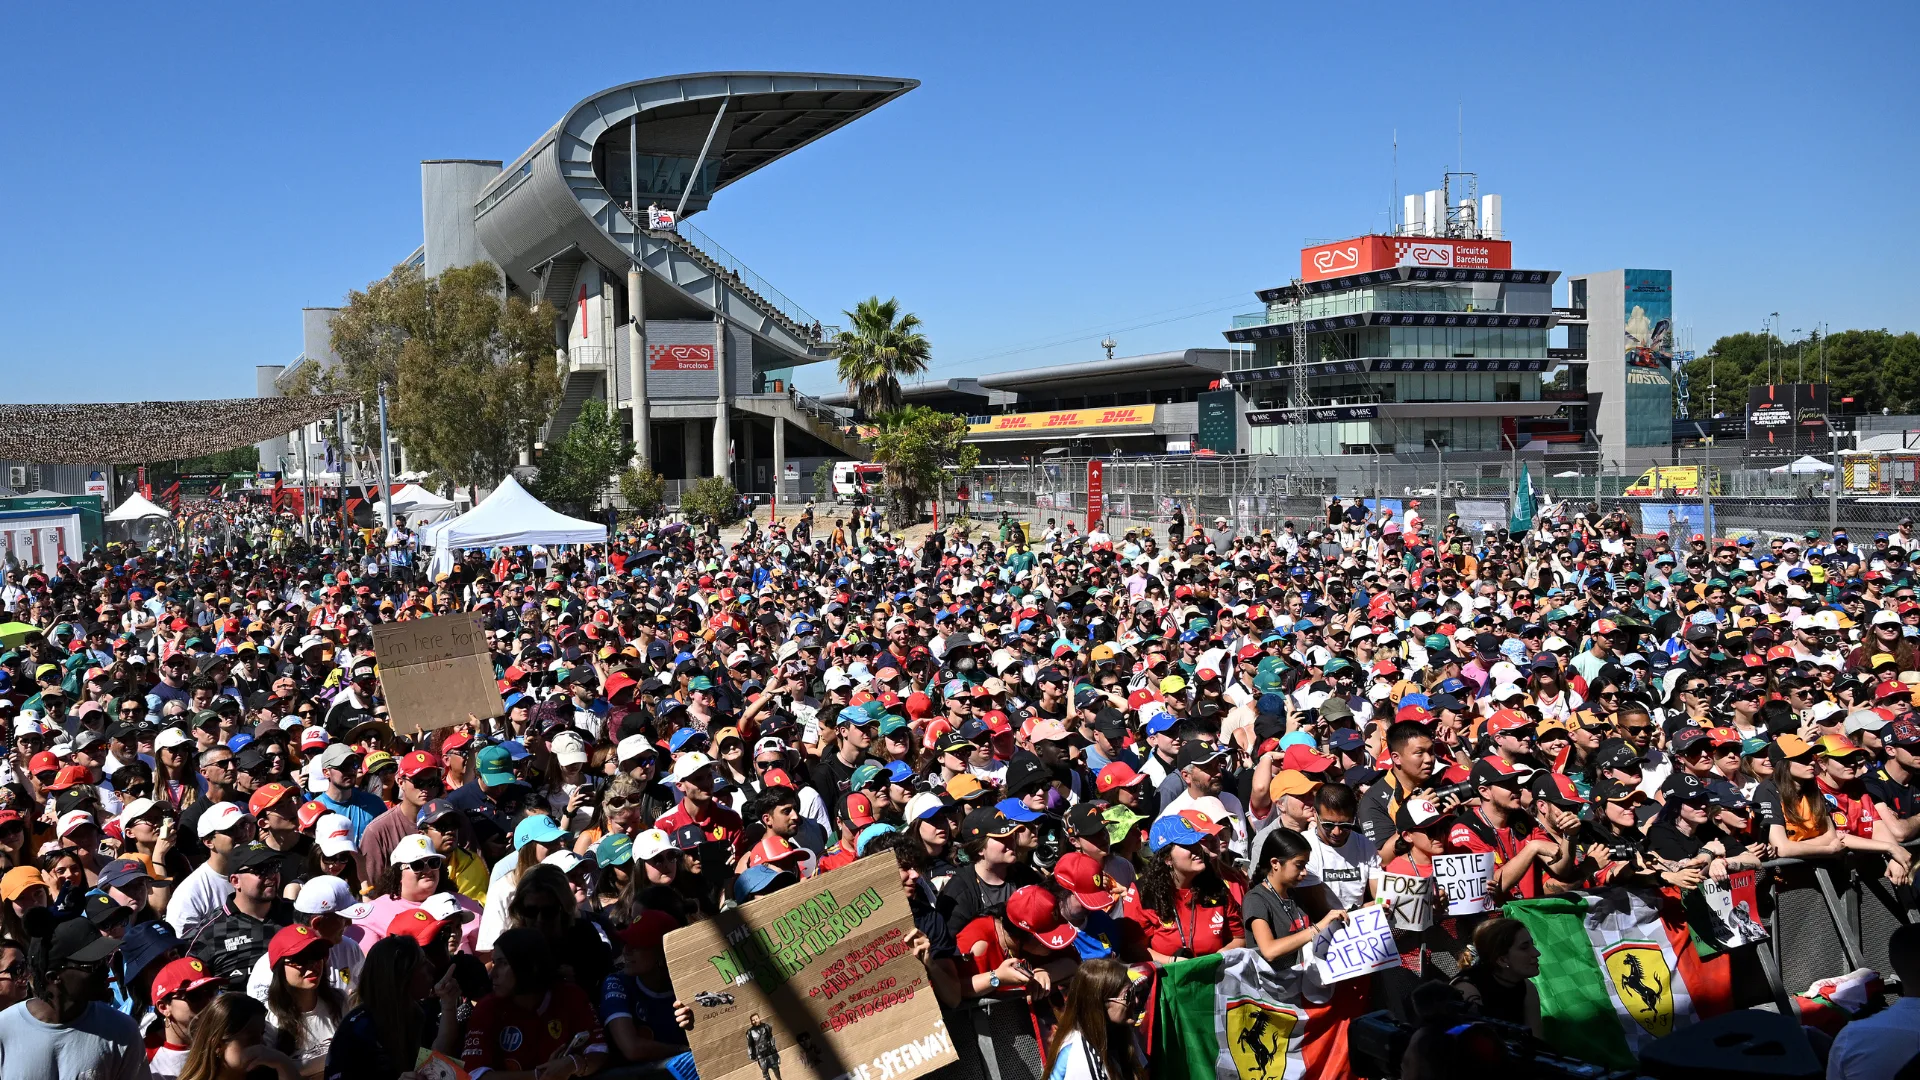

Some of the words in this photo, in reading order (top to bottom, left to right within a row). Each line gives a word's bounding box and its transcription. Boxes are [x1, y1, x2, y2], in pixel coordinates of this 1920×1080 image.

[1456, 246, 1479, 254] Circuit
[1480, 247, 1489, 255] de
[1456, 256, 1488, 264] Barcelona
[1627, 372, 1670, 385] NOSTRA
[1000, 417, 1027, 429] DHL
[1048, 413, 1078, 426] DHL
[1102, 410, 1135, 423] DHL
[378, 634, 407, 657] I'm
[414, 634, 443, 650] here
[451, 626, 484, 646] from
[380, 654, 442, 678] MEXICO
[306, 731, 320, 739] 16
[522, 834, 529, 842] 63
[684, 831, 691, 839] 1
[1434, 854, 1486, 877] ESTIE
[355, 906, 365, 915] 16
[726, 924, 750, 947] THE
[1052, 936, 1063, 944] 44
[1315, 909, 1389, 952] ALLEZ
[756, 886, 884, 995] BORTOGROGU
[1323, 931, 1399, 974] PIERRE
[821, 959, 845, 979] NICO
[735, 971, 754, 987] AND
[502, 1030, 518, 1050] hp
